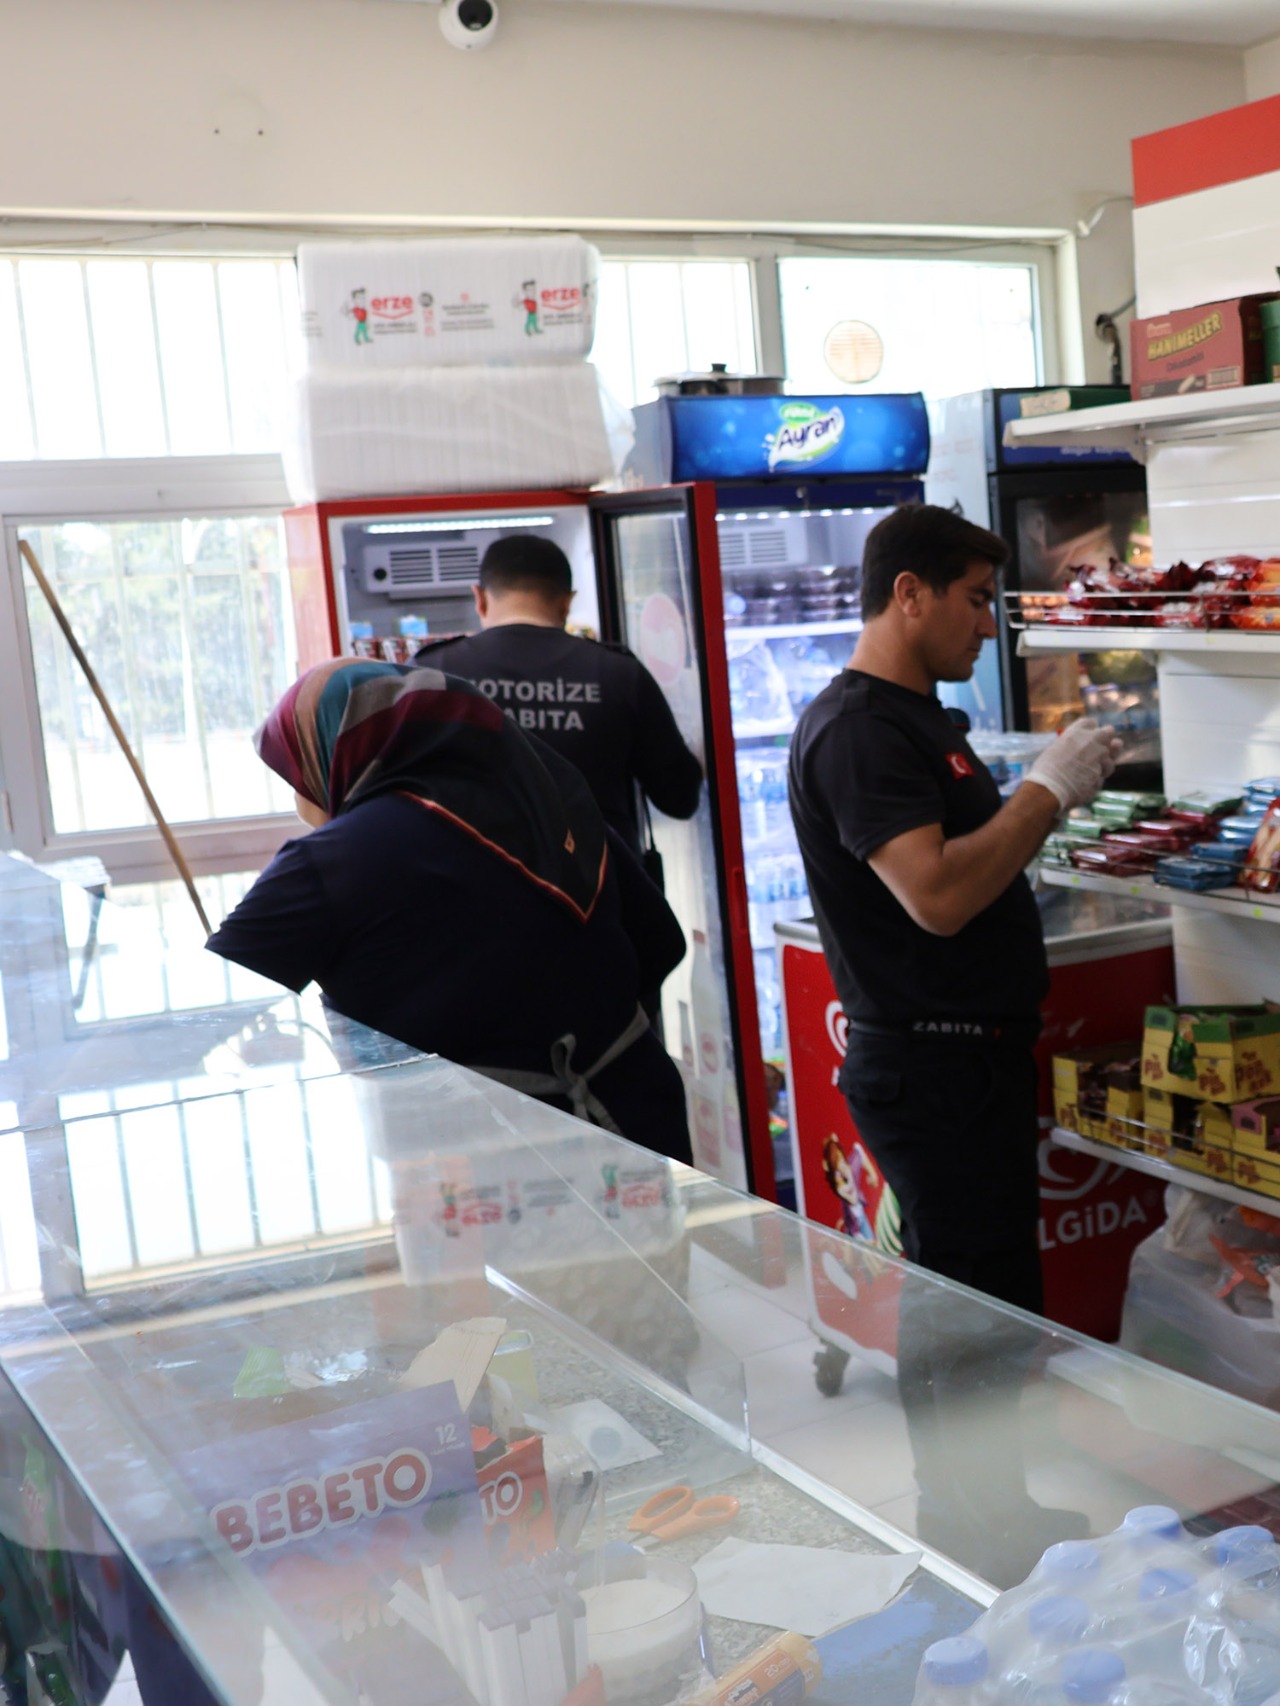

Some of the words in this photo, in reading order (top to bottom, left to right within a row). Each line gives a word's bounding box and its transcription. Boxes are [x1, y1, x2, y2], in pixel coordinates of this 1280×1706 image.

[371, 296, 413, 311] erze
[541, 287, 580, 302] erze
[1147, 310, 1222, 362] HANIMELLER
[779, 417, 836, 452] Ayran
[472, 678, 601, 703] OTORİZE
[504, 708, 584, 731] ABITA
[912, 1021, 983, 1036] ZABITA
[1038, 1194, 1148, 1253] LGiDA
[434, 1422, 458, 1445] 12
[214, 1451, 429, 1554] BEBETO
